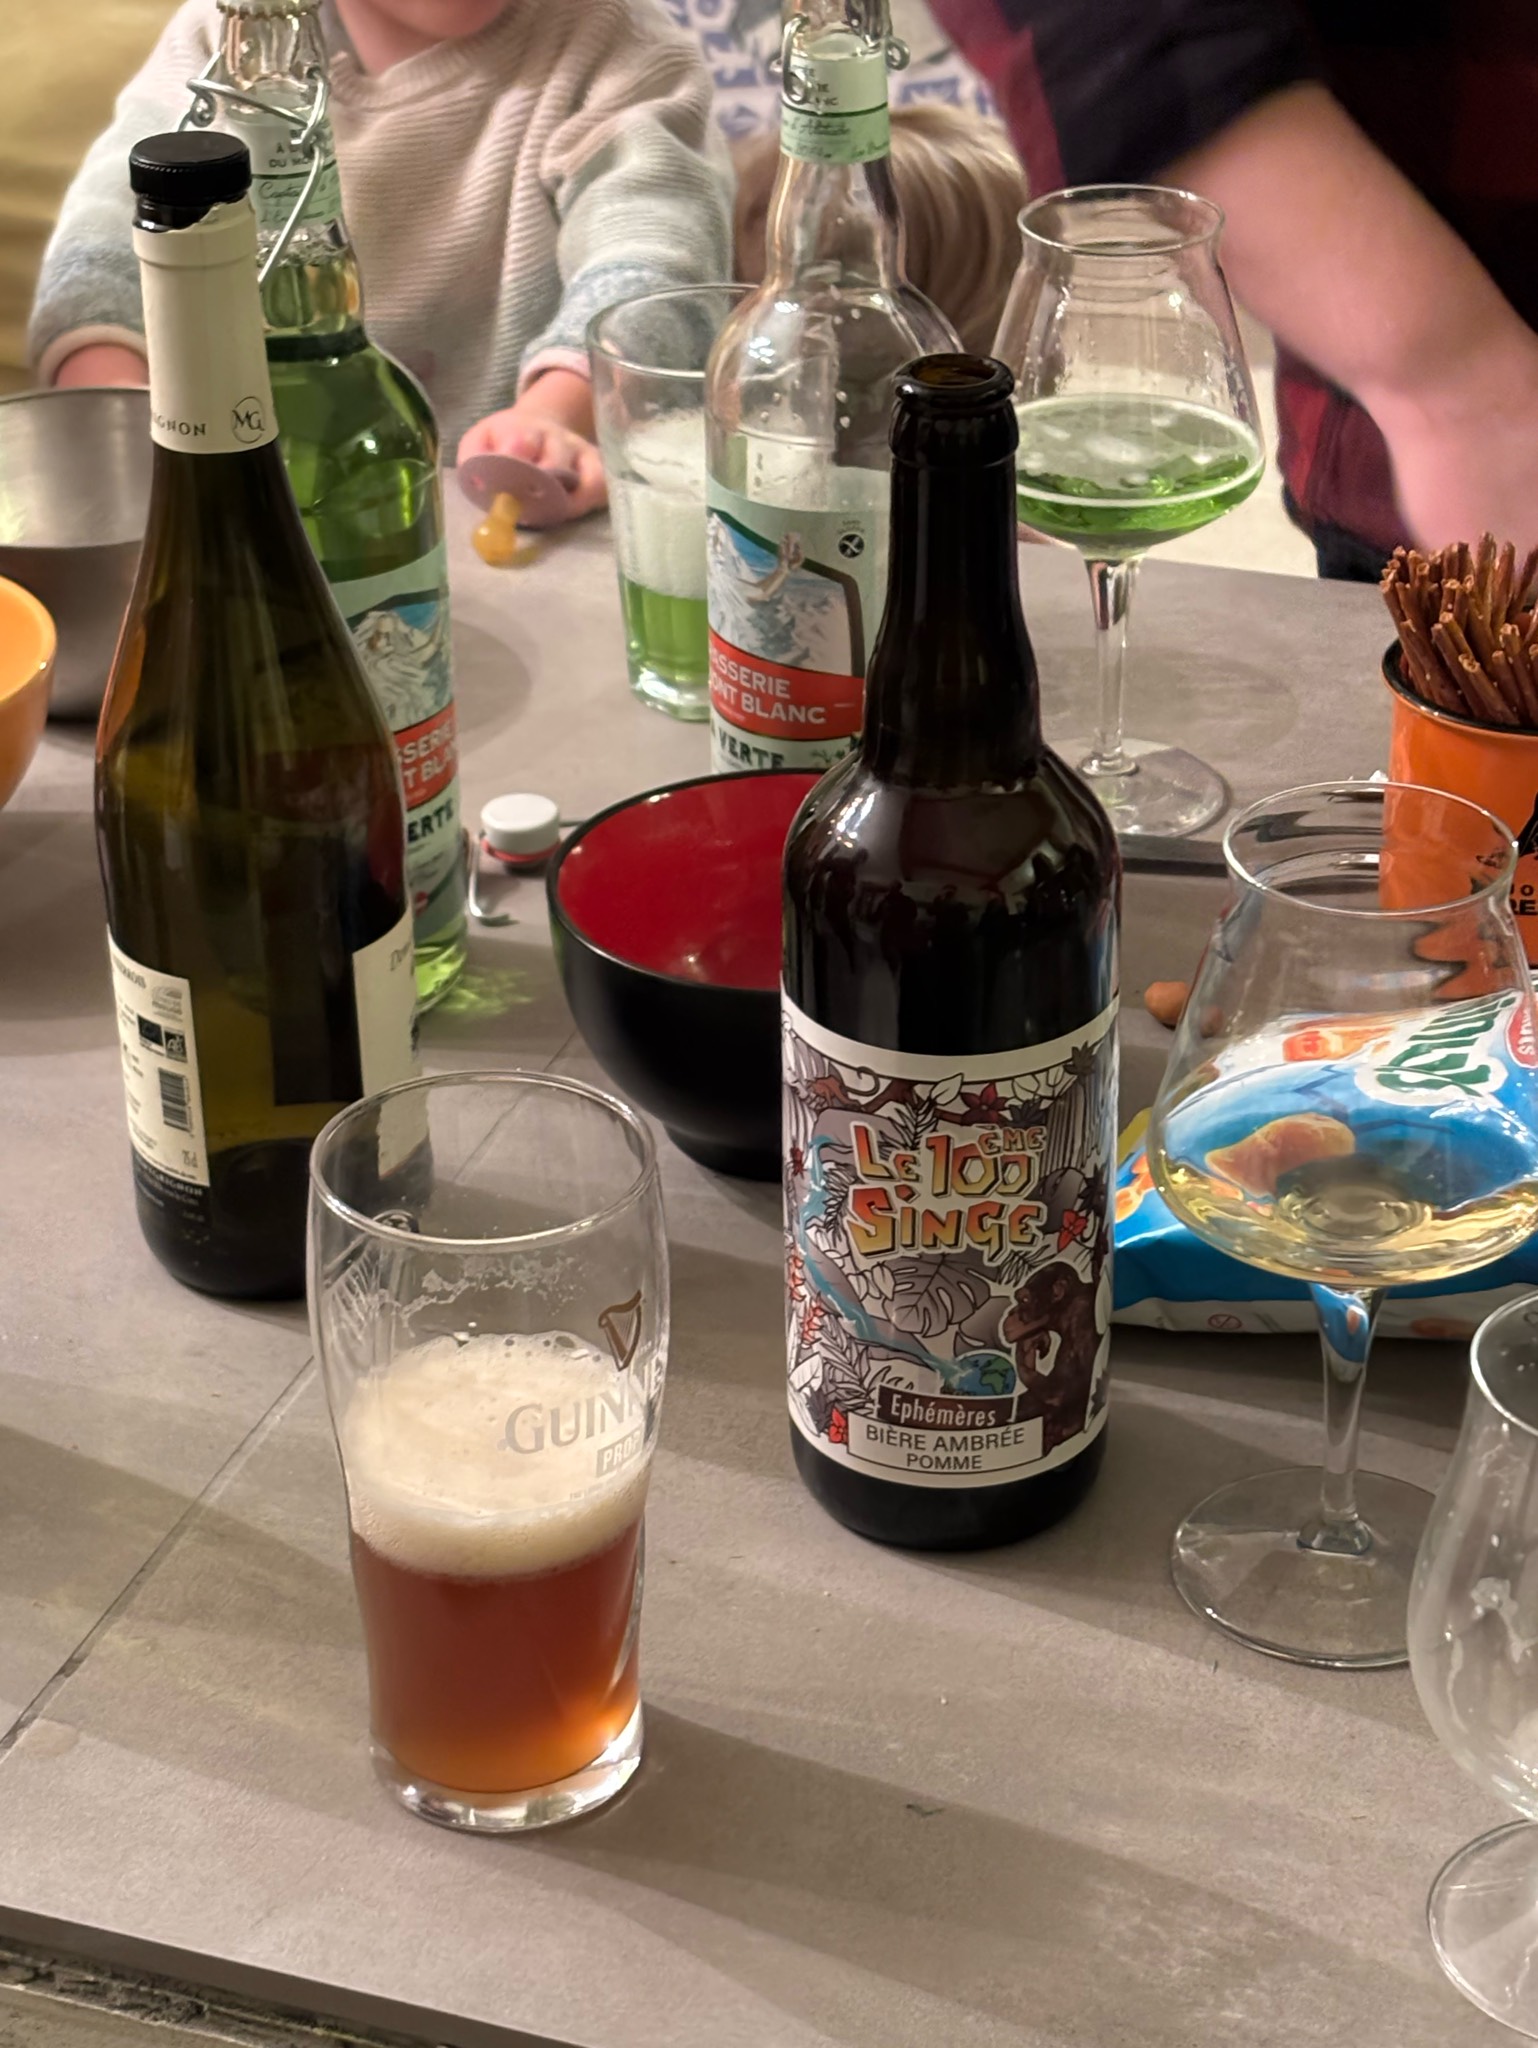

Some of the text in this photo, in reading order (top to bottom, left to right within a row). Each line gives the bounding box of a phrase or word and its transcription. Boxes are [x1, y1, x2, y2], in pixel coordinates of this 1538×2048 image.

[741, 693, 827, 724] BLANC
[866, 1424, 1025, 1452] BIÈRE AMBRÉE
[907, 1453, 983, 1470] POMME
